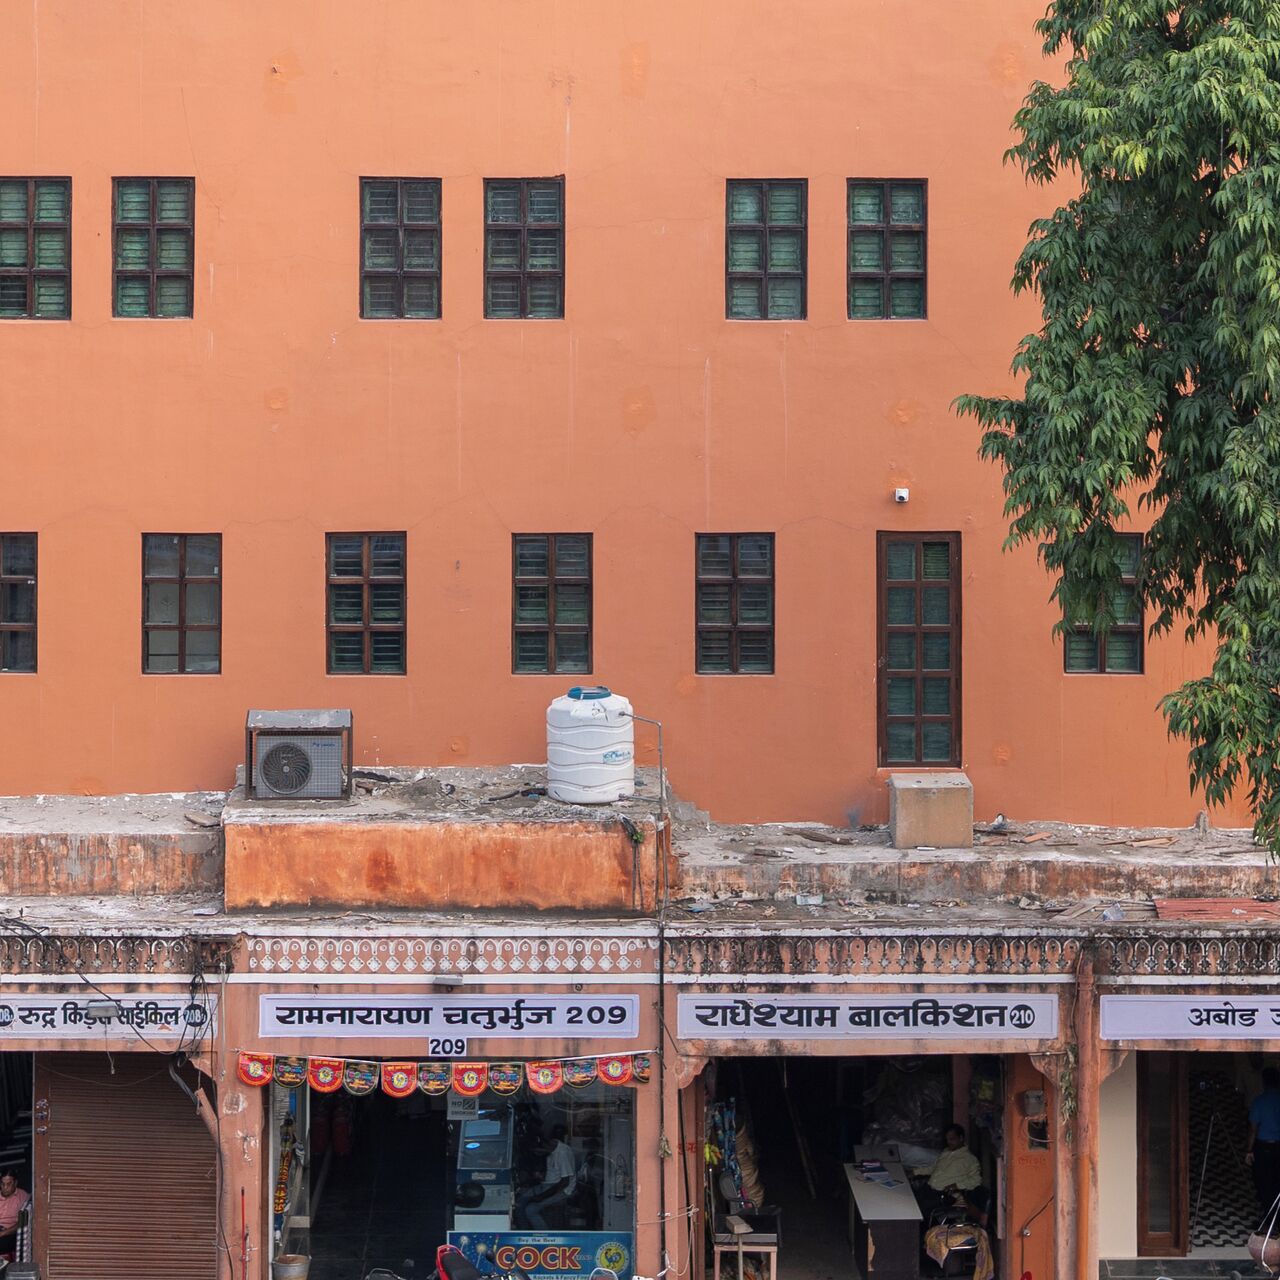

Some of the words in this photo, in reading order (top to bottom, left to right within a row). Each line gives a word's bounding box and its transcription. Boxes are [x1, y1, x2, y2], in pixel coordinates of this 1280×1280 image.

[18, 1007, 58, 1028] रुद्र
[118, 1001, 181, 1029] साईकिल
[276, 1006, 431, 1025] रामनारायण
[443, 999, 556, 1030] चतुर्भुज
[566, 1006, 627, 1025] 209
[695, 999, 840, 1027] राधेश्याम
[848, 998, 1008, 1027] बालकिशन
[1010, 1009, 1035, 1025] 210
[1188, 1001, 1259, 1027] अबोड
[429, 1037, 466, 1055] 209
[495, 1246, 582, 1270] COCK
